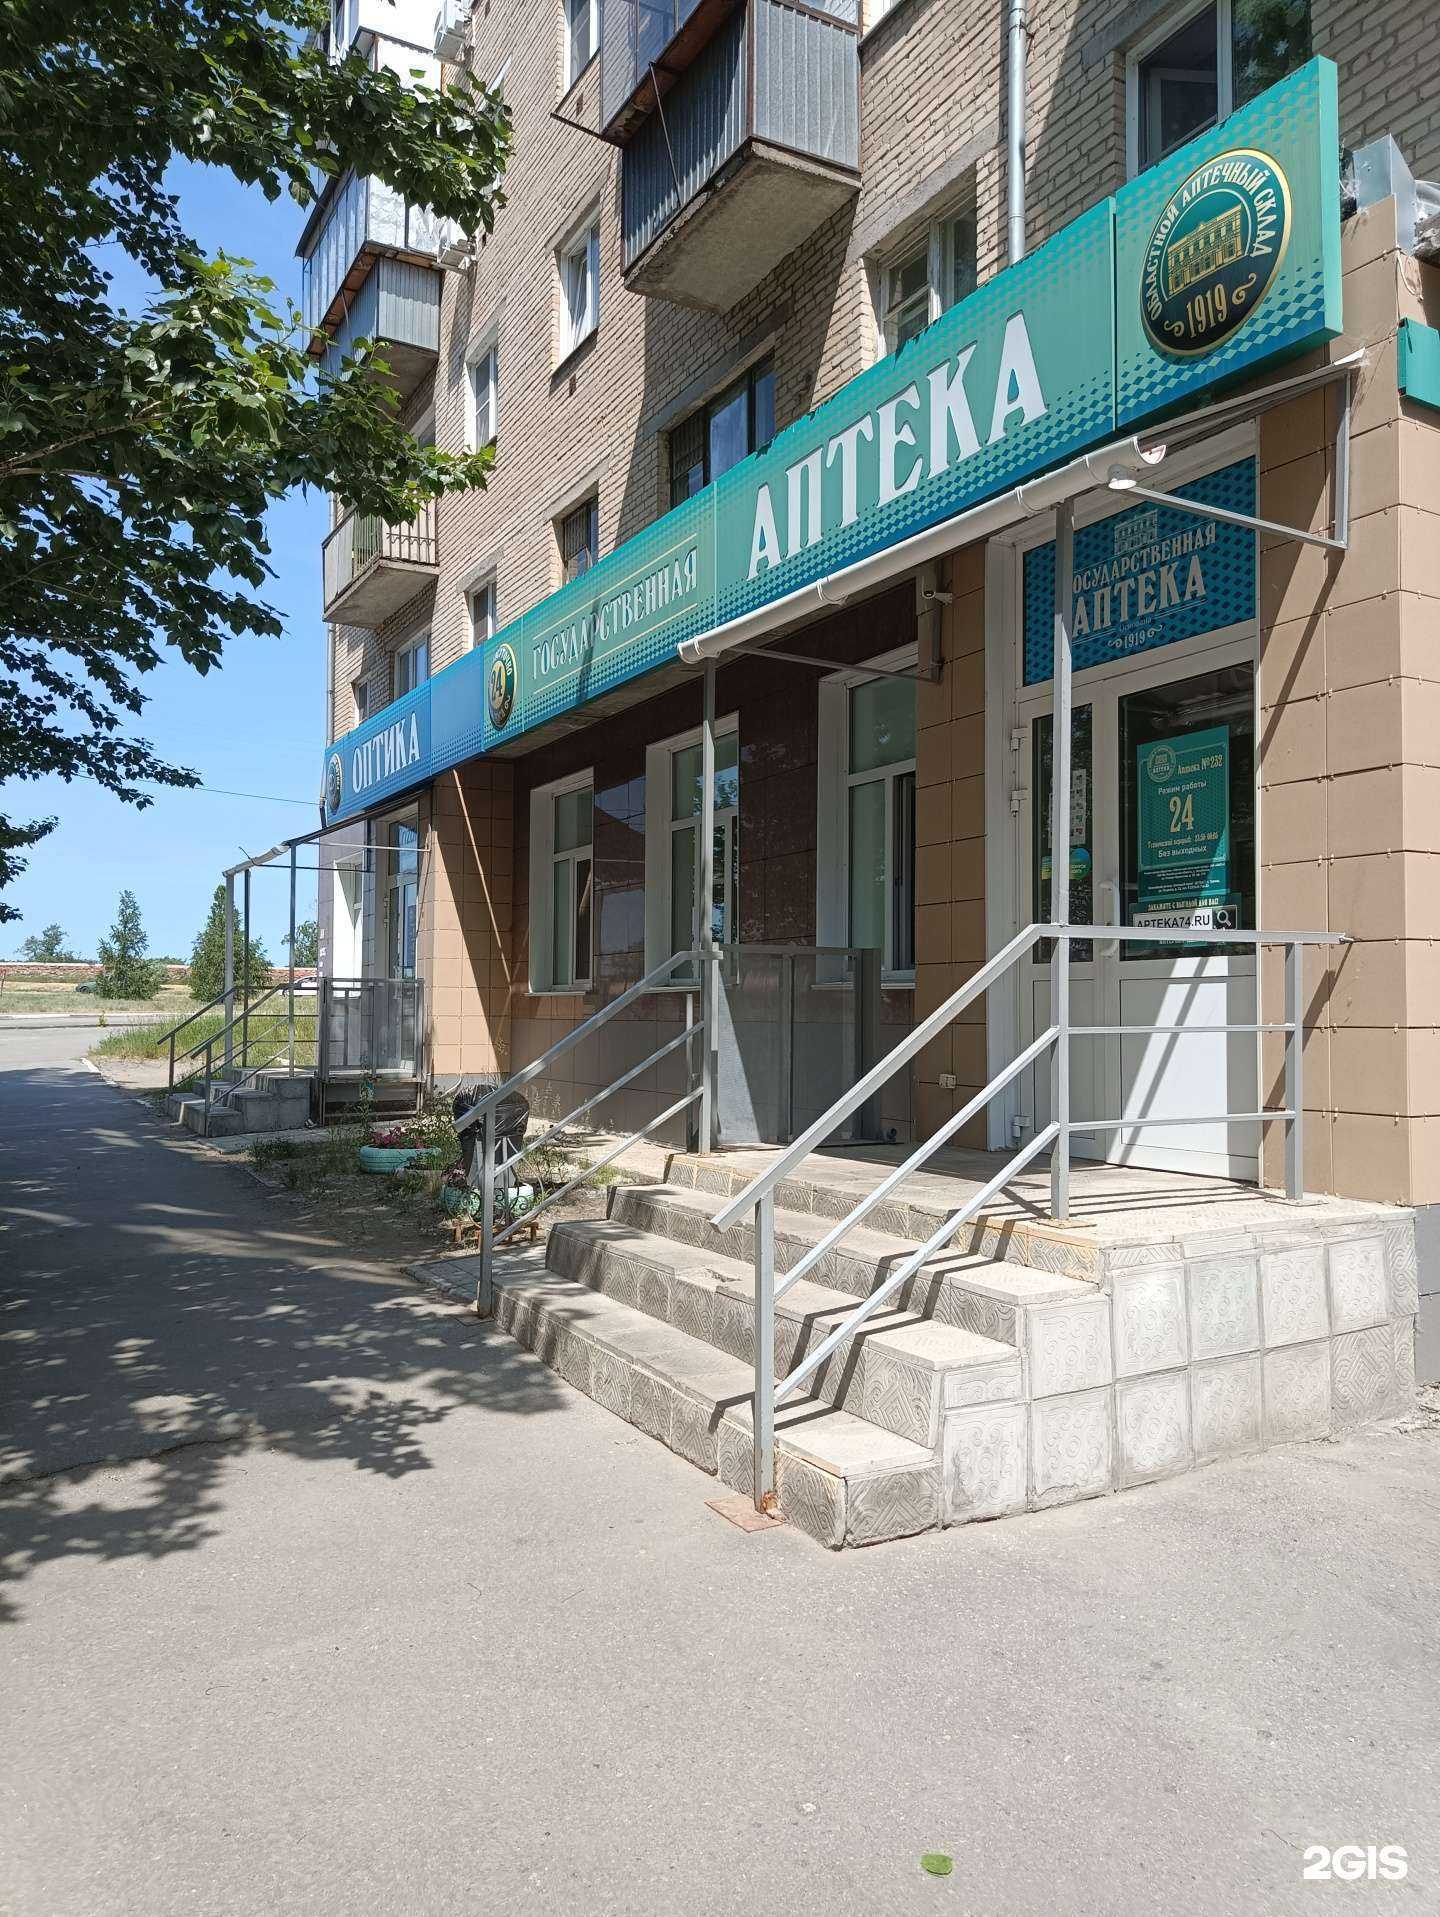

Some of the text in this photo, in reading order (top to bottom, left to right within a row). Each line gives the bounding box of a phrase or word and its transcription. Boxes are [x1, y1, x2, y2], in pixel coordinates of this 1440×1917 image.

[1182, 161, 1271, 207] АПТЕЧНЫЙ
[1252, 188, 1277, 258] СКЛАД
[1186, 283, 1228, 338] 1919
[747, 309, 1048, 581] АПТЕКА
[1073, 521, 1216, 594] ОСУДАРСТВЕННАЯ
[532, 547, 698, 680] ГОСУДАРСТВЕННАЯ
[1073, 555, 1206, 638] АПТЕКА
[1124, 630, 1146, 648] 1919
[352, 712, 420, 793] ОПТИКА
[1169, 794, 1194, 834] 24
[1182, 780, 1207, 792] работы
[1158, 845, 1207, 858] Без выходных
[1137, 915, 1210, 929] APTEKA74.RU
